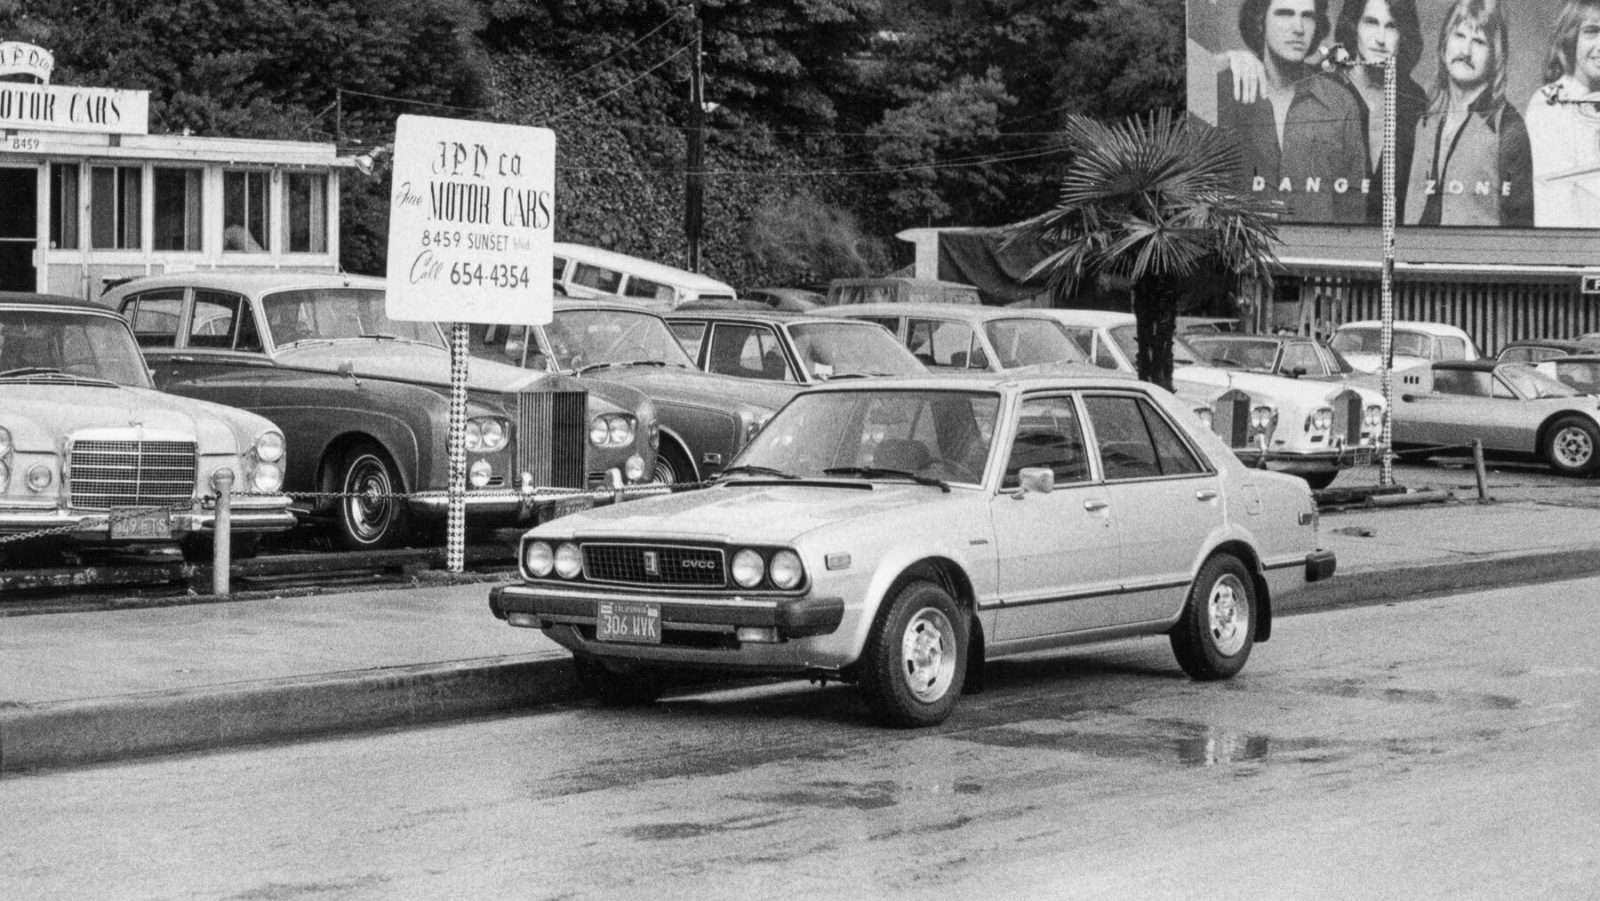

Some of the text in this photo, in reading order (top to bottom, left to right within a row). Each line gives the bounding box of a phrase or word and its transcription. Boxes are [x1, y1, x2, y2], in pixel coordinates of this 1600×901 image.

[0, 89, 121, 125] OTOR CARS
[12, 138, 40, 150] 8459
[1252, 176, 1512, 196] DANGE ZONE
[427, 180, 491, 225] MOTOR
[502, 186, 551, 230] CARS
[421, 228, 461, 248] 8459
[467, 232, 509, 251] SUNSET
[449, 261, 530, 288] 654-4354
[682, 559, 716, 569] CVCC
[603, 614, 628, 635] 306
